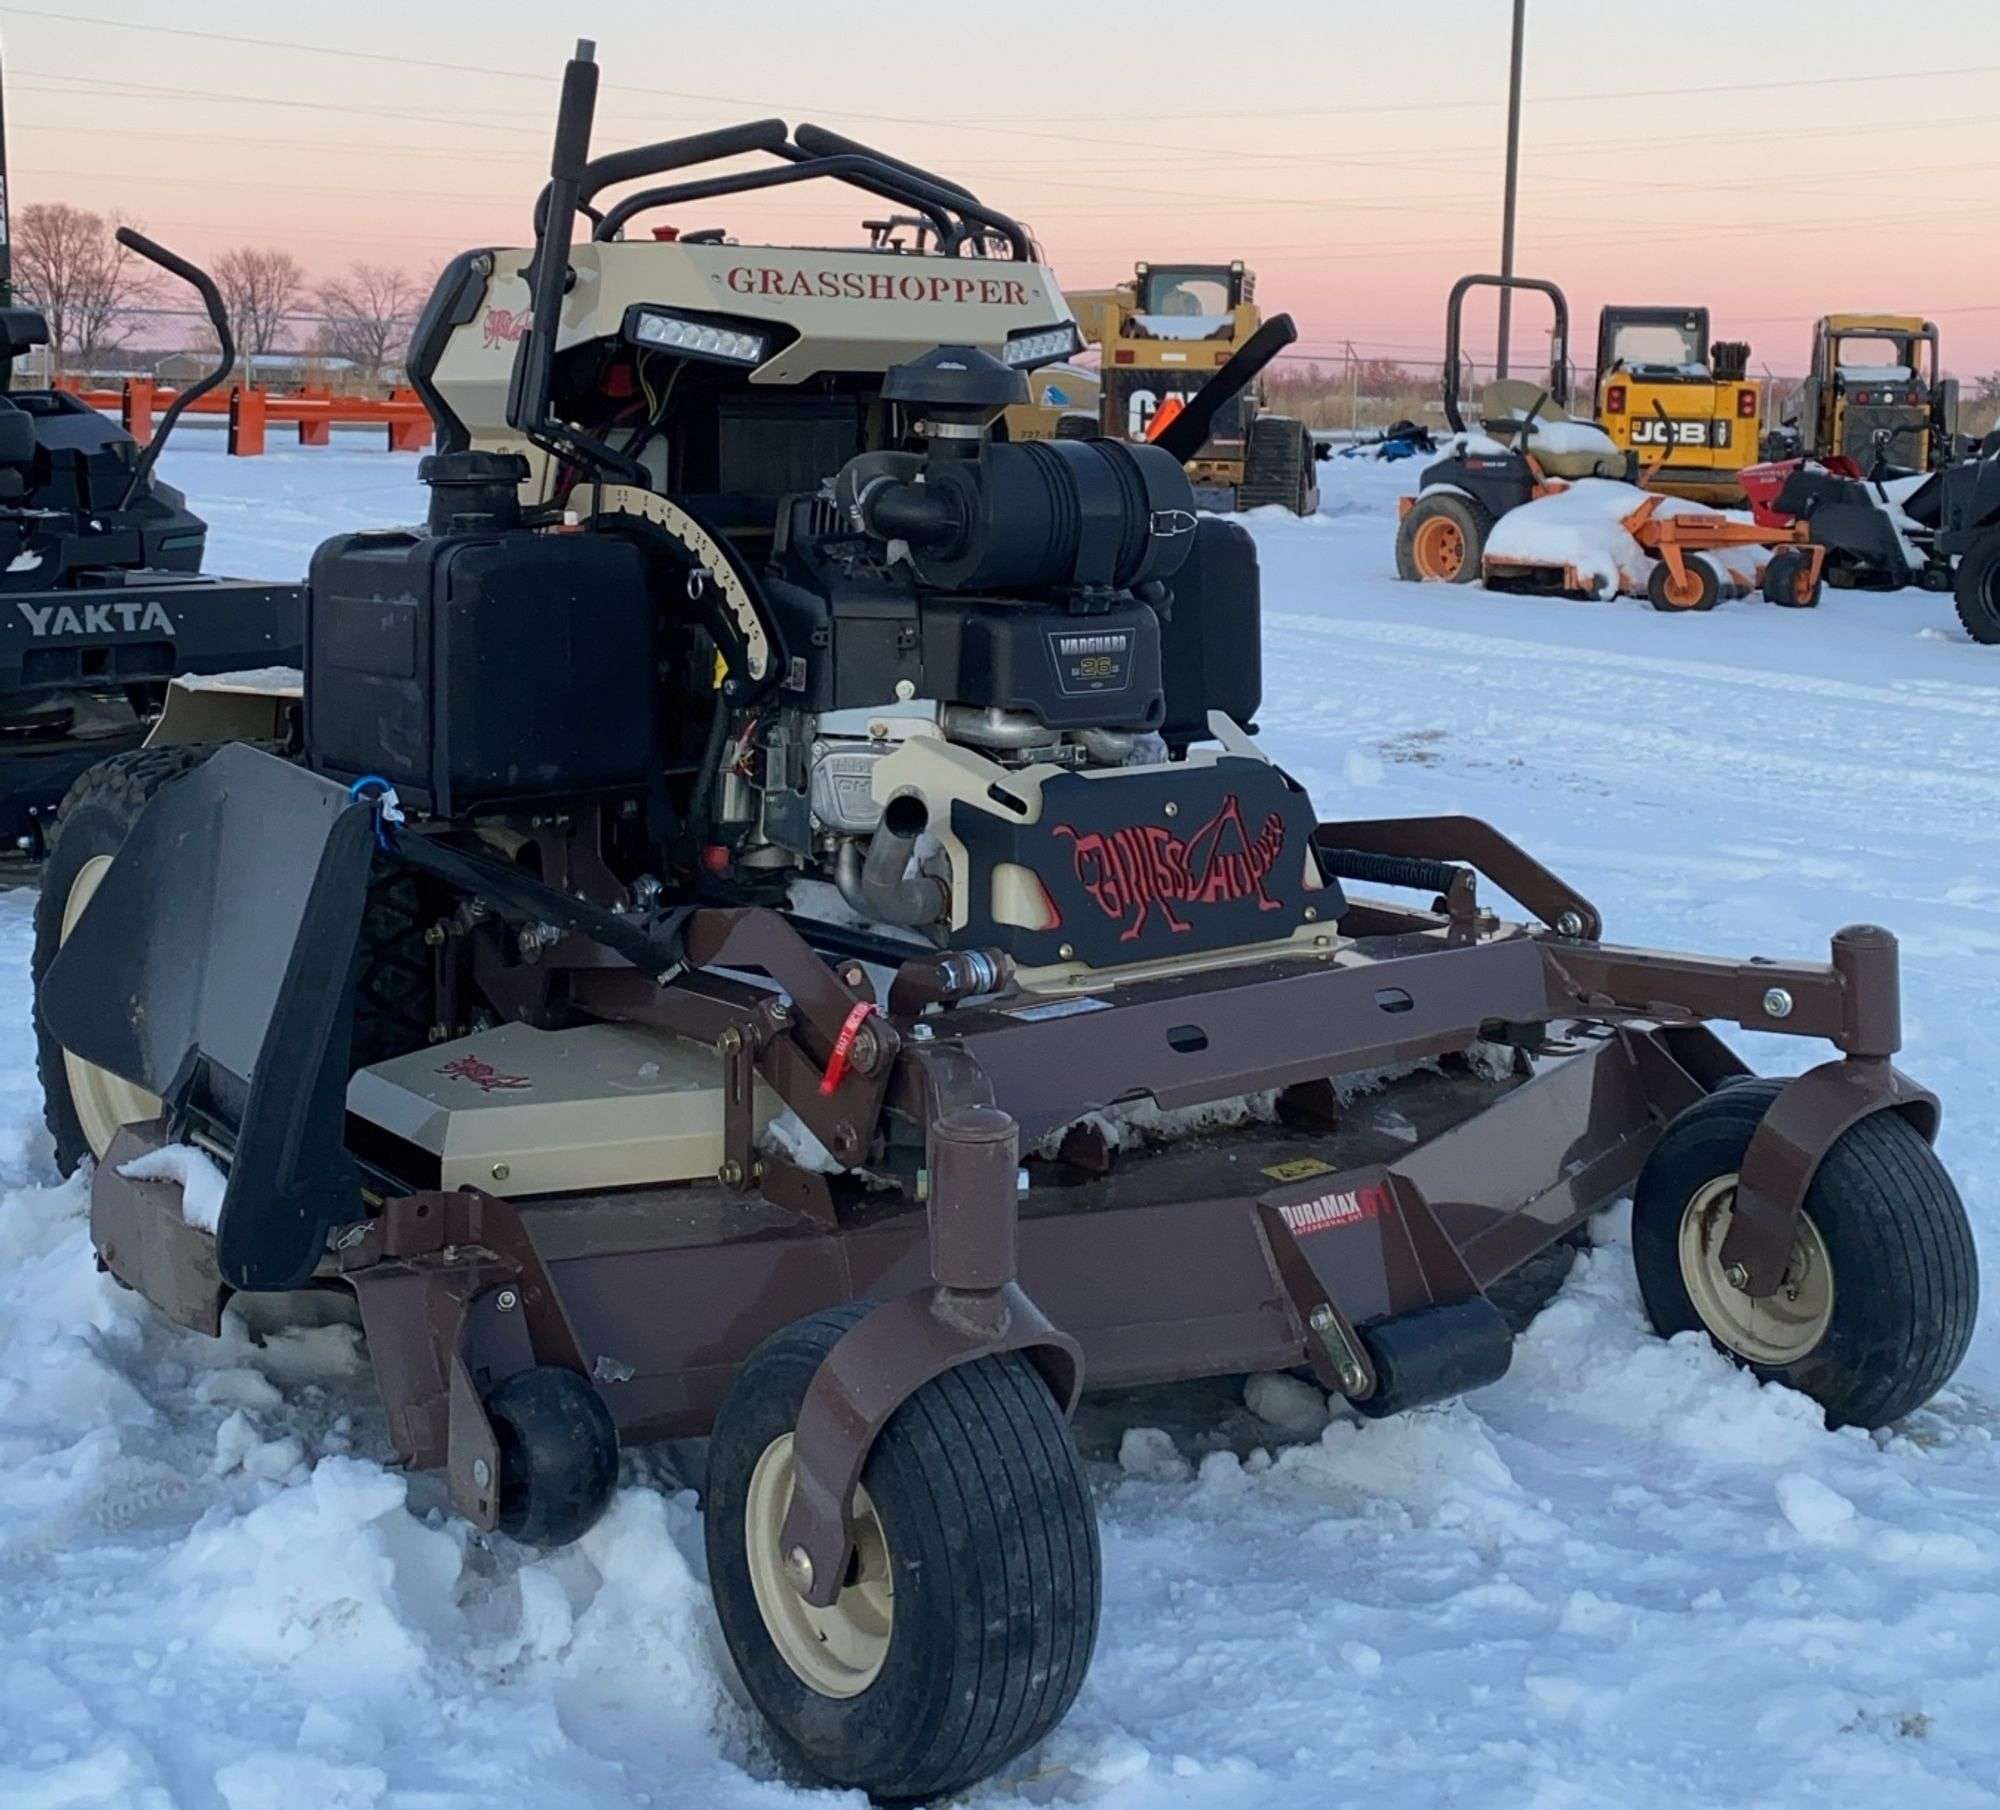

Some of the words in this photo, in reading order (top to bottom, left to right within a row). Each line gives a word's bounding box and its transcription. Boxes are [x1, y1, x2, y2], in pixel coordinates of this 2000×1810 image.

[727, 266, 1029, 305] GRASSHOPPER
[1631, 421, 1706, 443] JCB
[16, 602, 177, 636] YAKTA
[1060, 635, 1127, 656] VANGUARD
[1080, 656, 1112, 677] 26
